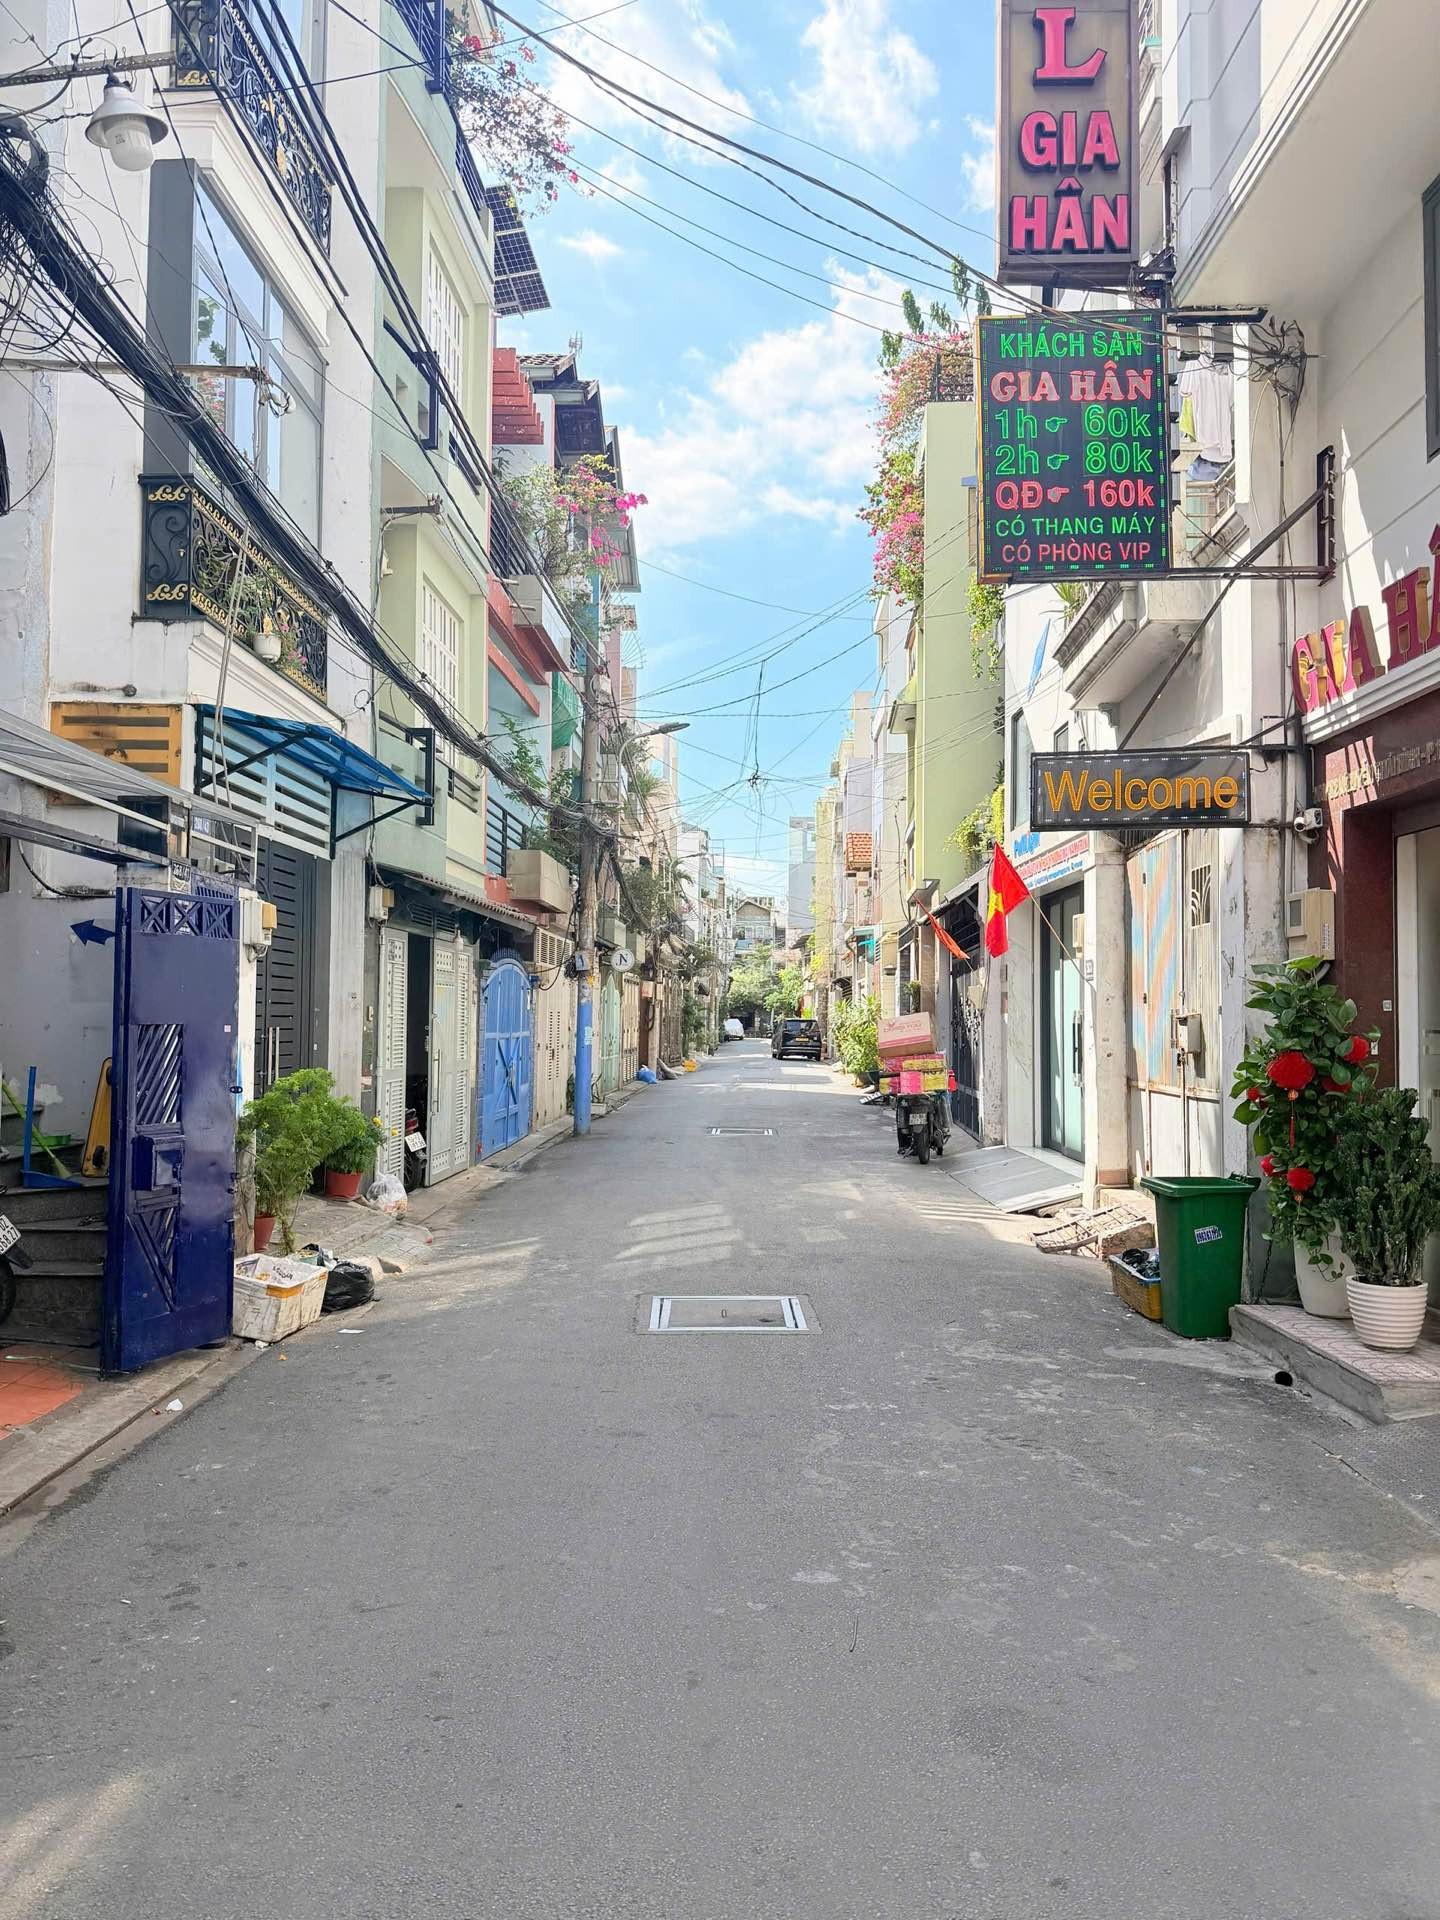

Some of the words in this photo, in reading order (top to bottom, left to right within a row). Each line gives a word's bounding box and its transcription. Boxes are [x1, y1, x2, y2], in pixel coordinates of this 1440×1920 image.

[1034, 7, 1108, 84] L
[1019, 110, 1121, 169] GIA
[1010, 176, 1130, 252] HÂN
[1000, 326, 1085, 359] KHÁCH
[1092, 331, 1142, 361] SẠN
[990, 370, 1060, 402] GIA
[1069, 359, 1153, 402] HÂN
[994, 408, 1038, 439] 1h
[1084, 404, 1152, 438] 60k
[995, 443, 1040, 475] 2h
[1085, 441, 1153, 475] 80k
[995, 480, 1043, 511] QĐ
[1083, 478, 1155, 508] 160k
[995, 514, 1025, 537] CÓ
[1032, 517, 1104, 536] THANG
[1111, 512, 1156, 535] MÁY
[1002, 539, 1031, 563] CÓ
[1038, 537, 1112, 562] PHÒNG
[1119, 542, 1151, 561] VIP
[1292, 603, 1386, 717] GIA
[1044, 768, 1240, 812] Welcome
